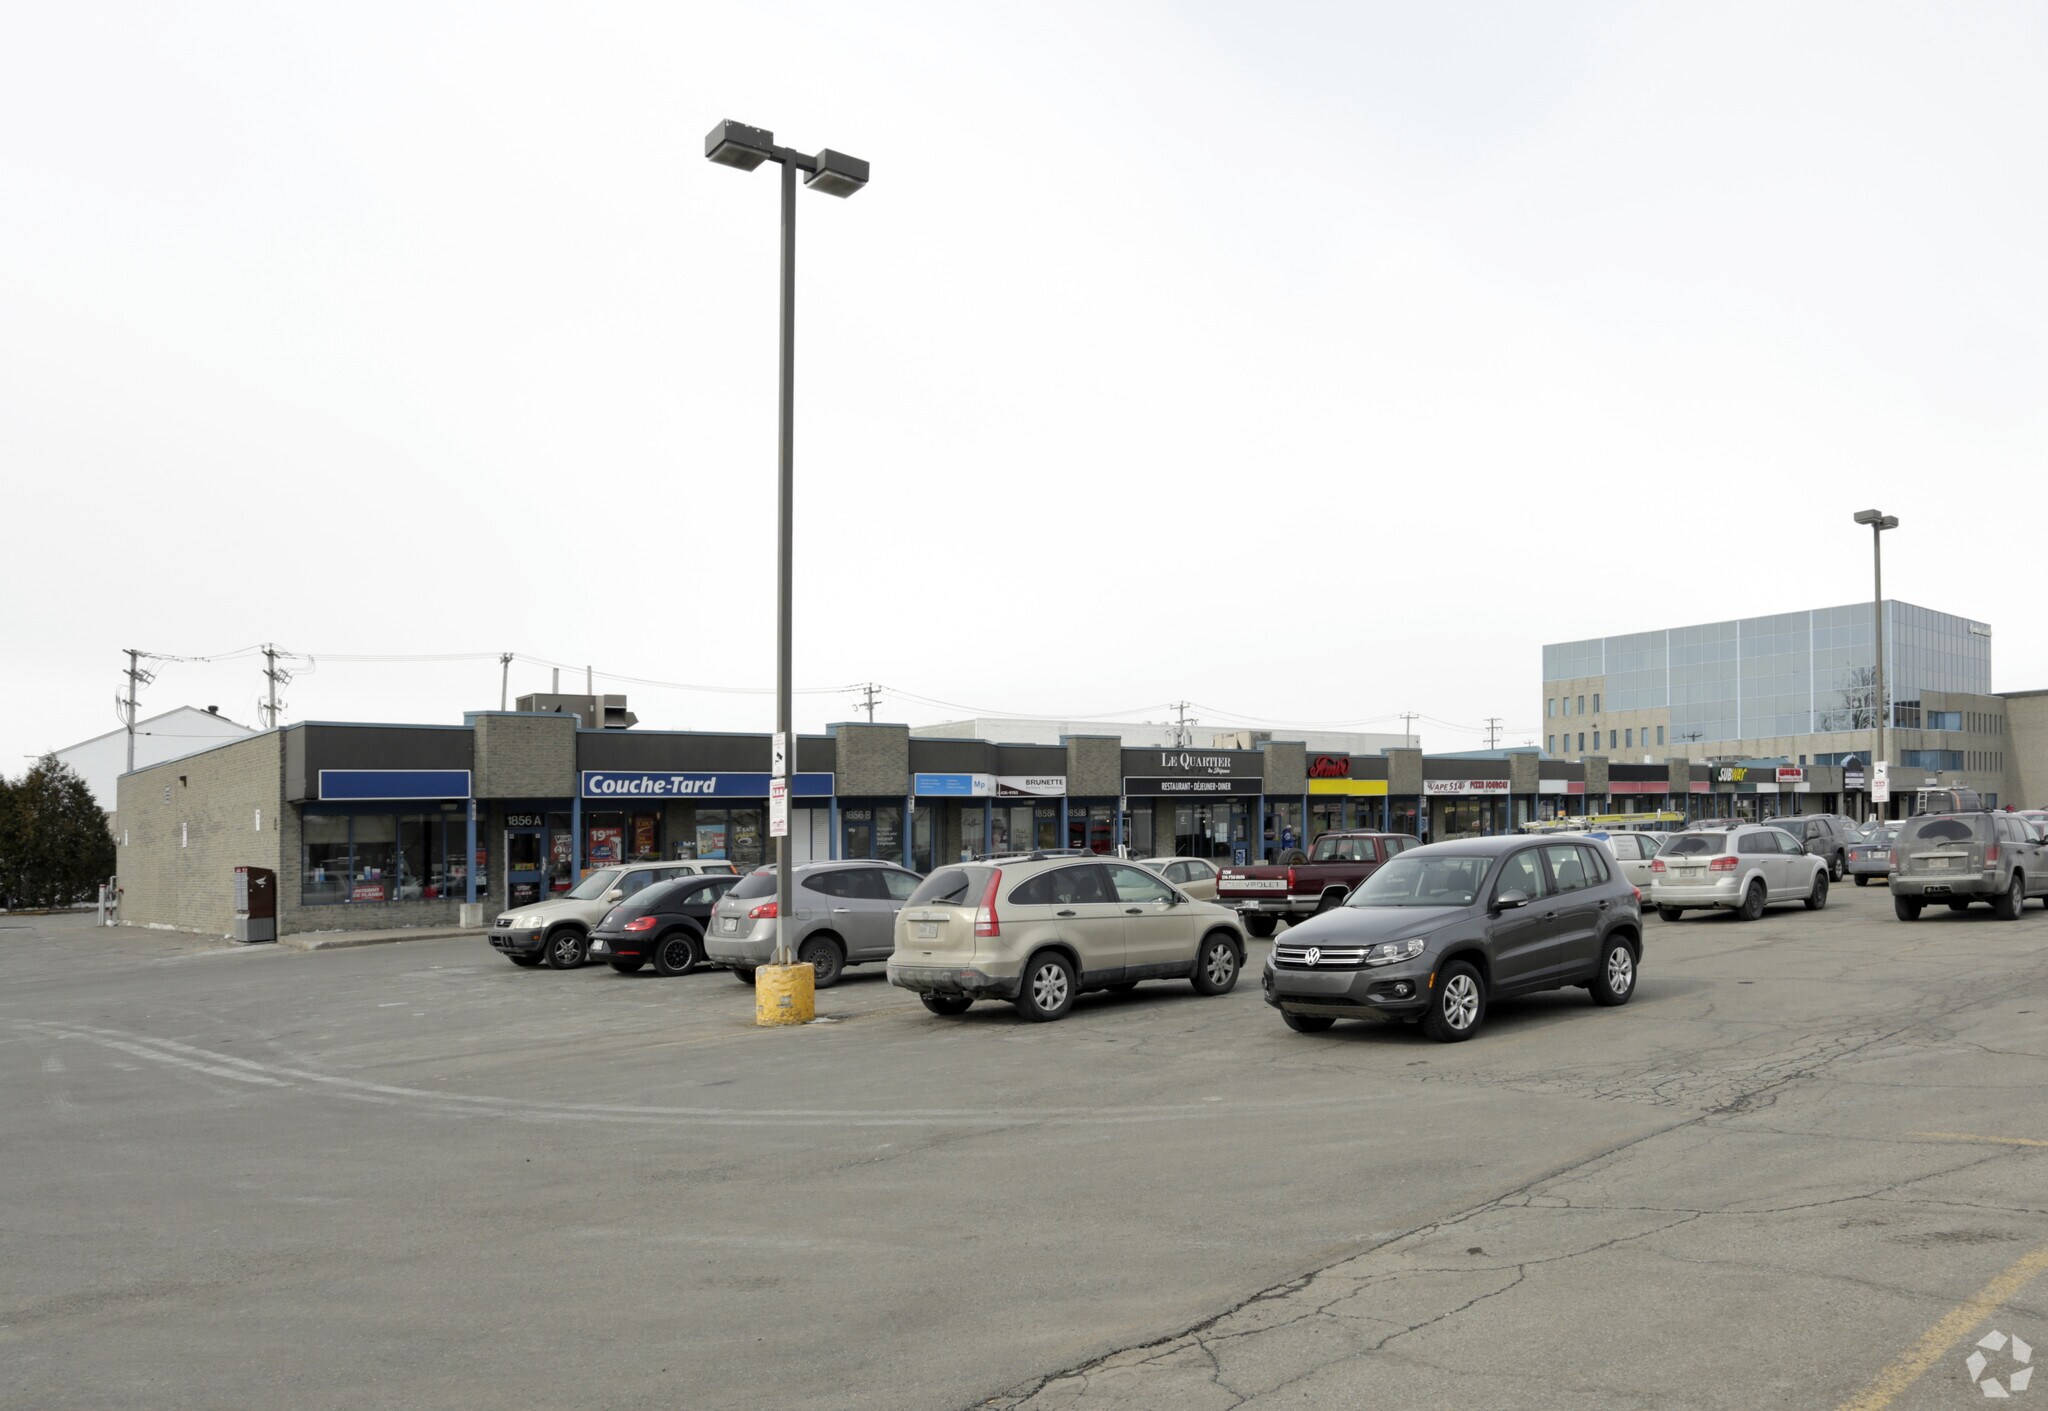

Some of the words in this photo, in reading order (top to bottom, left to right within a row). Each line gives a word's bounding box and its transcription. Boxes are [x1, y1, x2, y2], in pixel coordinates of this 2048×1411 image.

[1718, 767, 1748, 782] SUBWAY
[588, 775, 717, 794] Couche-Tard
[973, 780, 986, 790] Mp
[1161, 782, 1191, 791] RESTAURANT
[1470, 781, 1484, 789] PIZZA
[506, 815, 532, 826] 1856
[533, 815, 542, 826] A
